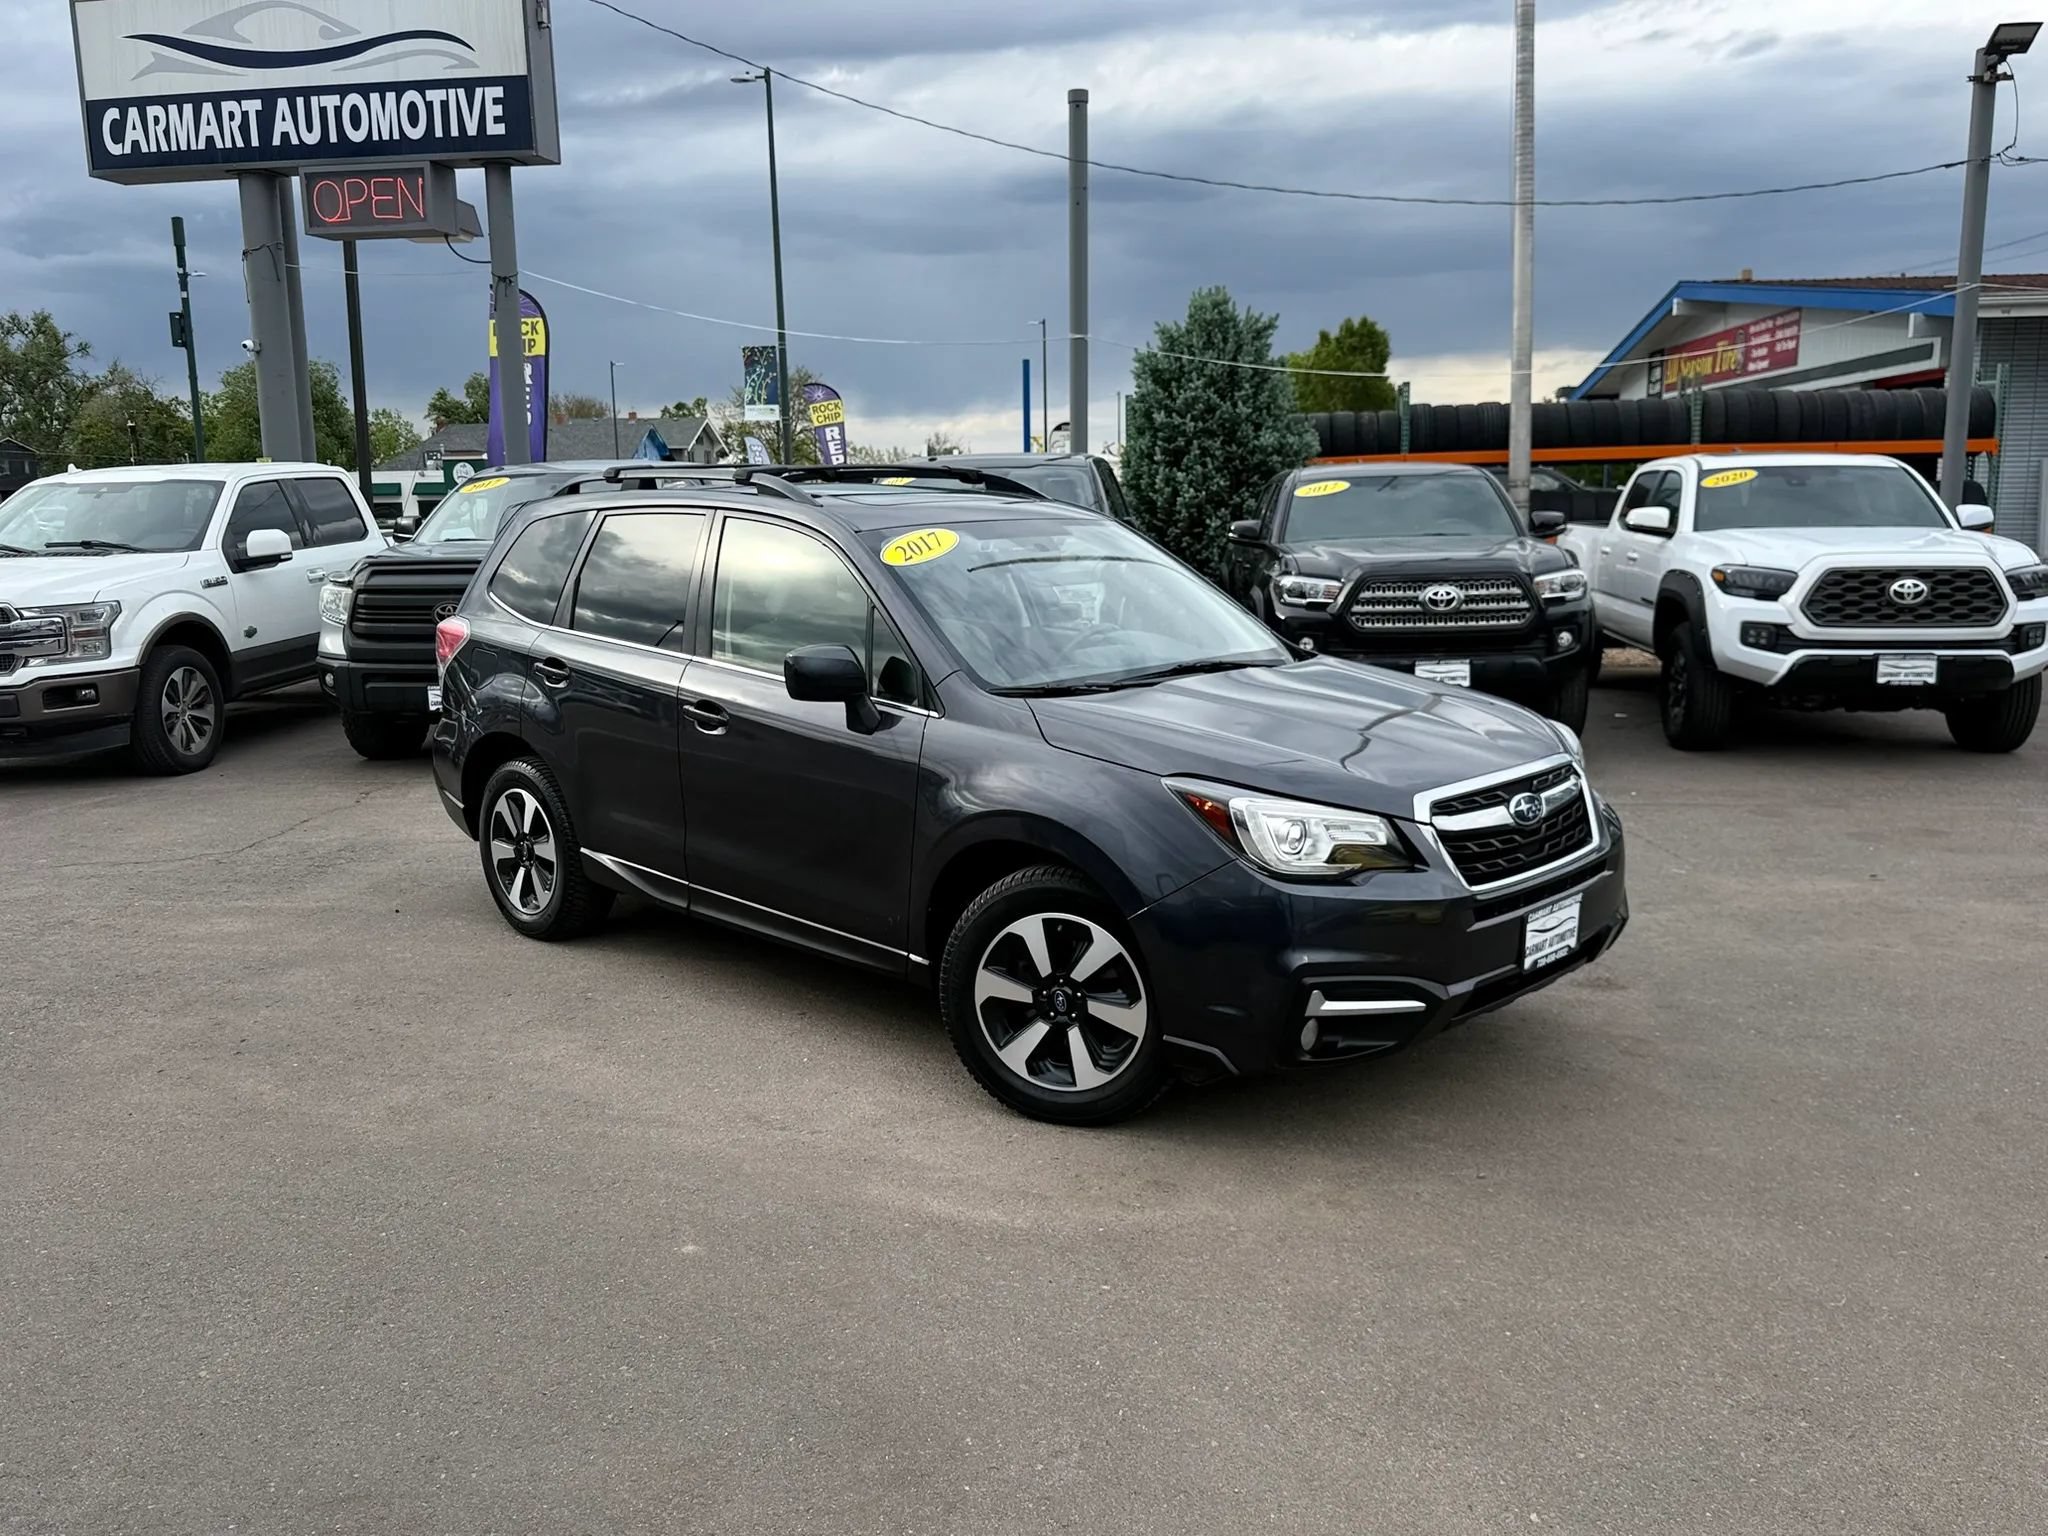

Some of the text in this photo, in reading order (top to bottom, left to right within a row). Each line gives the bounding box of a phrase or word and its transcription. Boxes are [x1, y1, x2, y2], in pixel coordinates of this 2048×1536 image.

[102, 86, 506, 156] CARMART AUTOMOTIVE
[313, 176, 425, 222] OPEN
[812, 402, 841, 415] ROCK
[816, 412, 841, 424] CHIP
[1712, 471, 1748, 486] 2020
[895, 532, 941, 562] 2017
